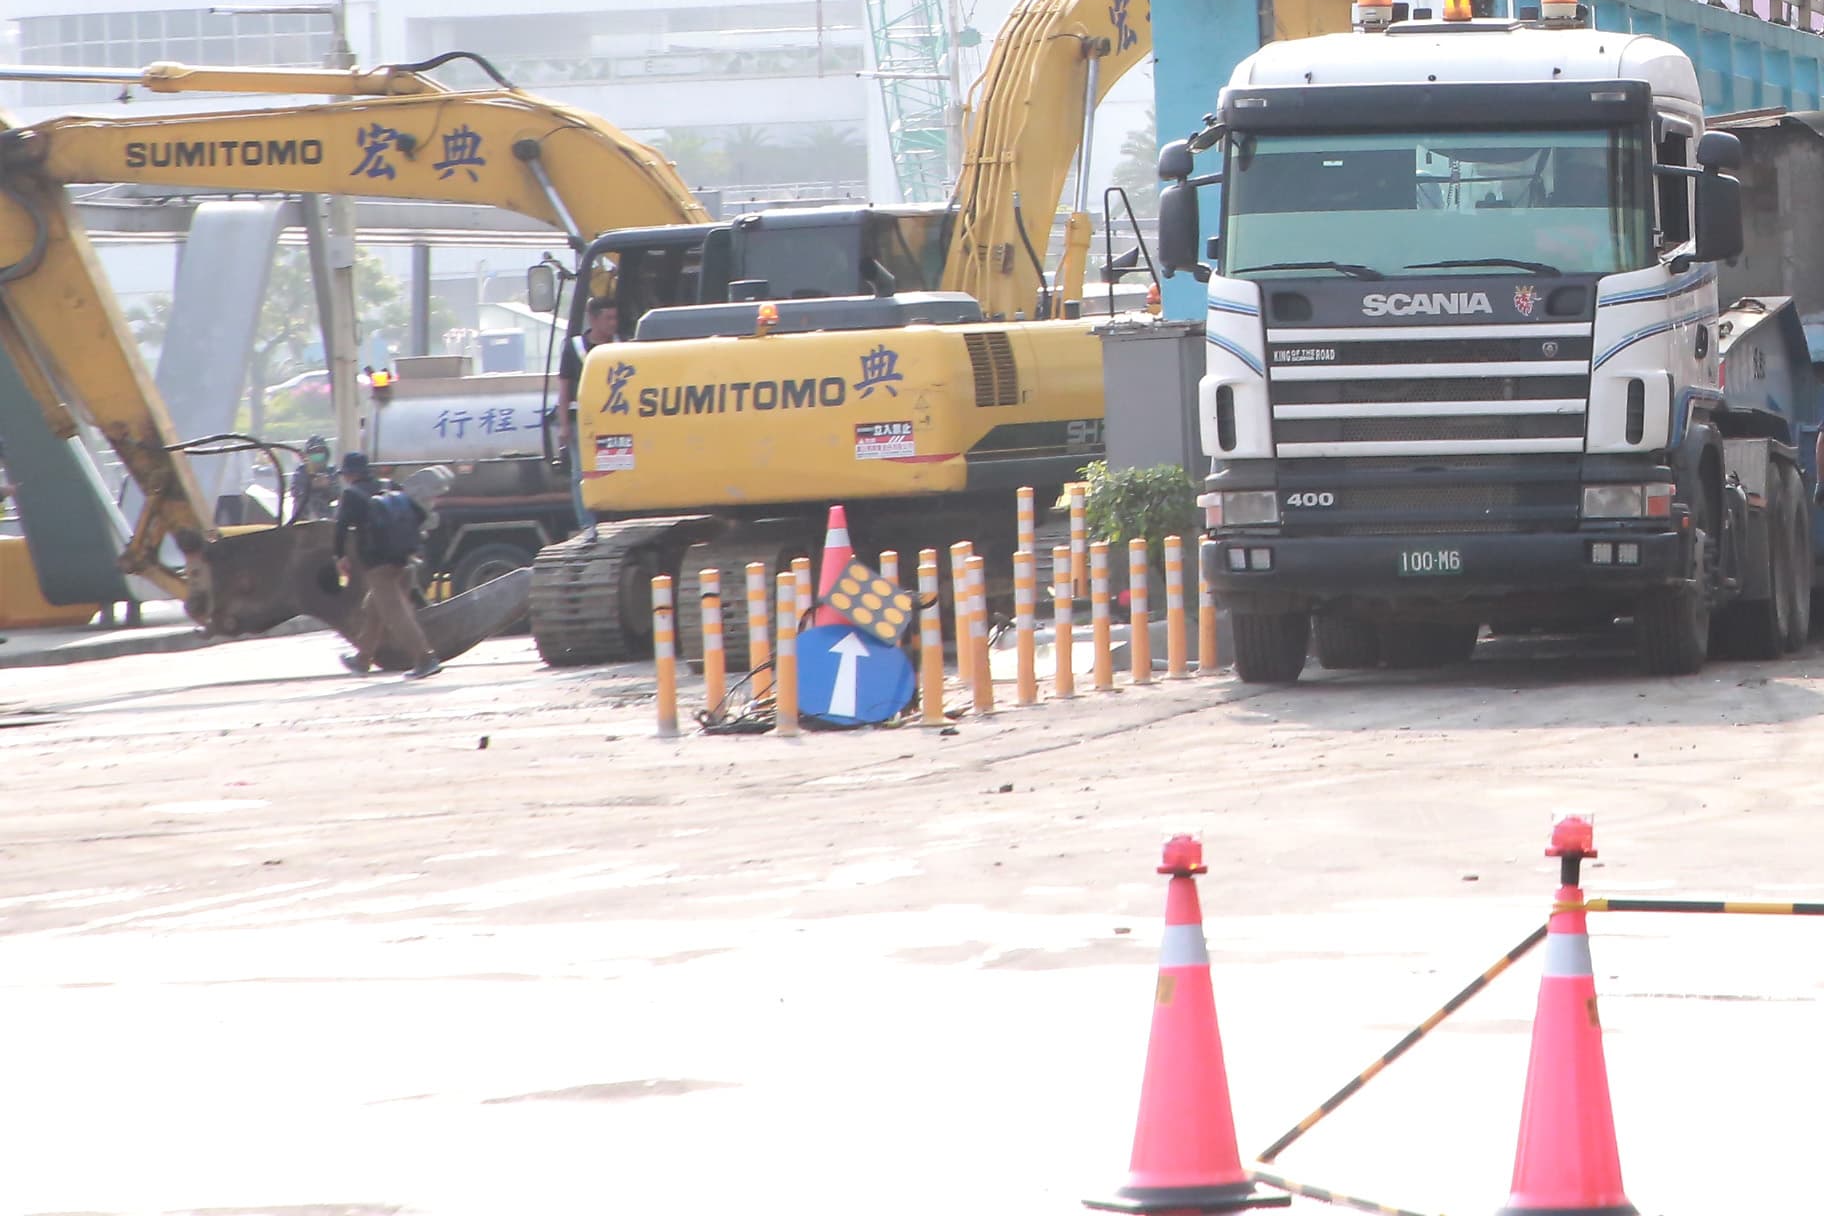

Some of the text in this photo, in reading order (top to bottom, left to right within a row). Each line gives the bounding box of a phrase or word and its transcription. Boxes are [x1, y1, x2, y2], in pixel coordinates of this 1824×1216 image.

[126, 139, 323, 168] SUMITOMO
[1362, 292, 1492, 316] SCANIA
[1273, 350, 1290, 361] KING
[1316, 349, 1335, 360] ROAD
[638, 377, 846, 418] SUMITOMO
[852, 344, 903, 399] 典
[1067, 420, 1105, 443] SH
[1287, 492, 1334, 508] 400
